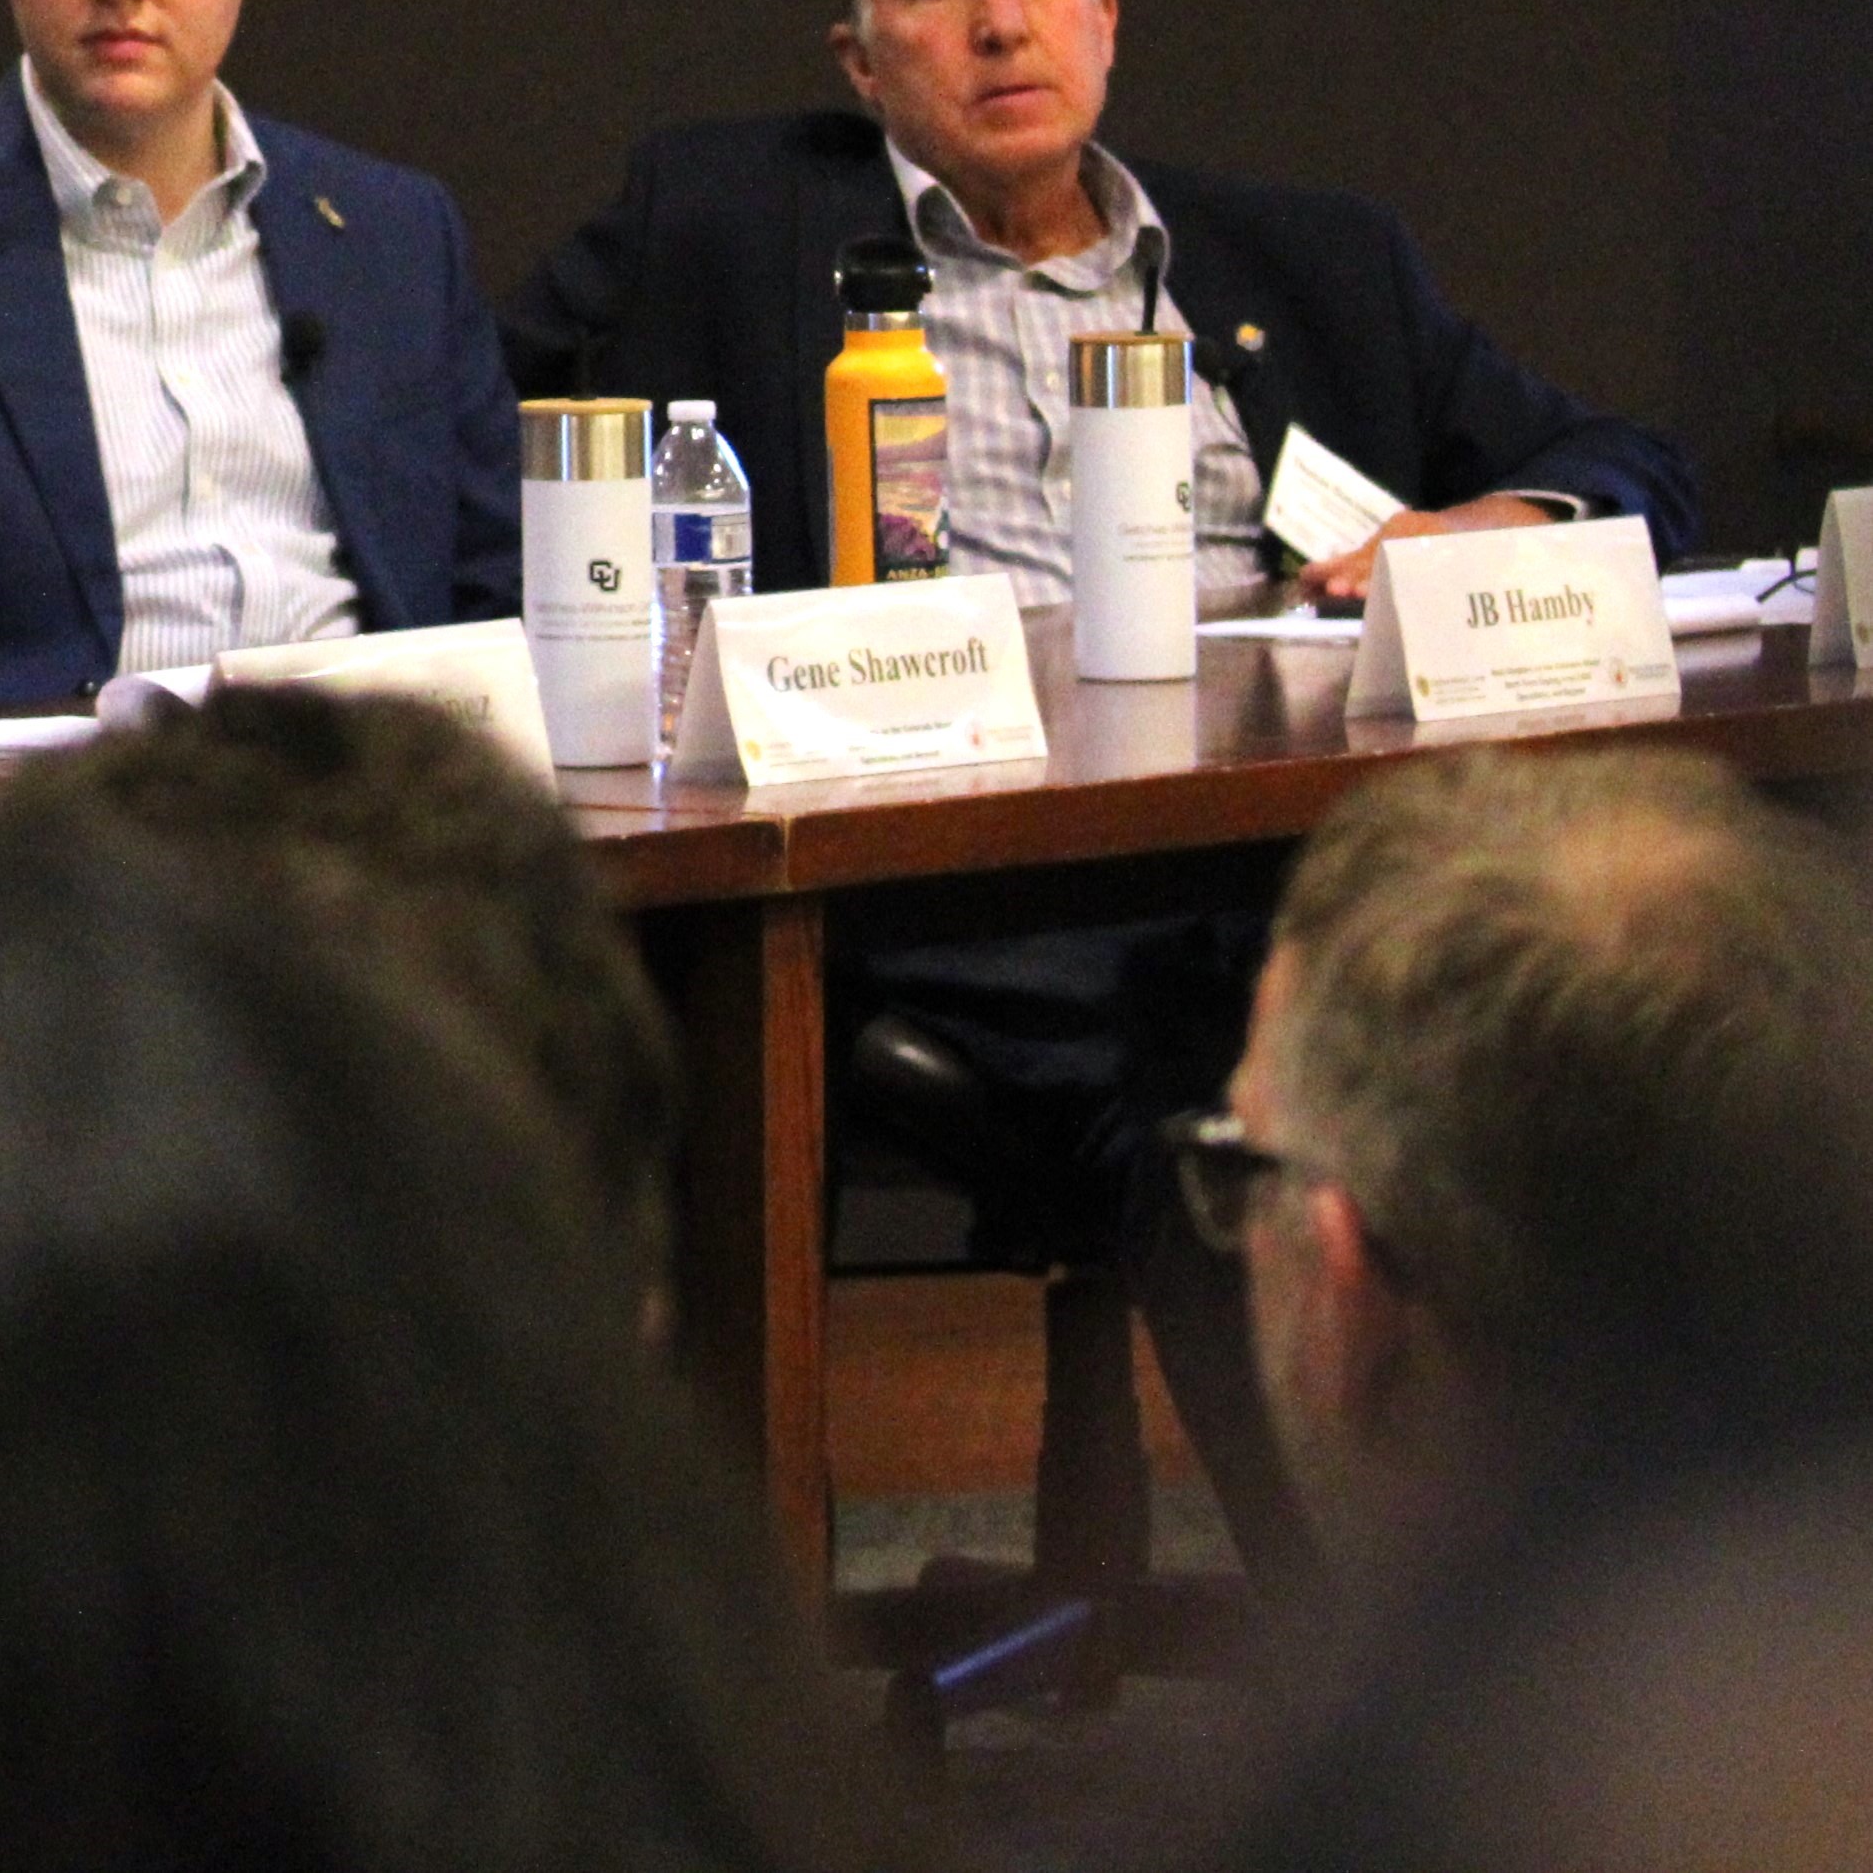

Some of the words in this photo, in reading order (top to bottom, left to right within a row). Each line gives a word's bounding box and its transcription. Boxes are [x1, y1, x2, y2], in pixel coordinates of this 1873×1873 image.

[589, 560, 620, 592] CU
[1466, 592, 1500, 628] JB
[1504, 584, 1595, 626] Hamby
[766, 655, 840, 692] Gene
[848, 636, 988, 684] Shawcroft
